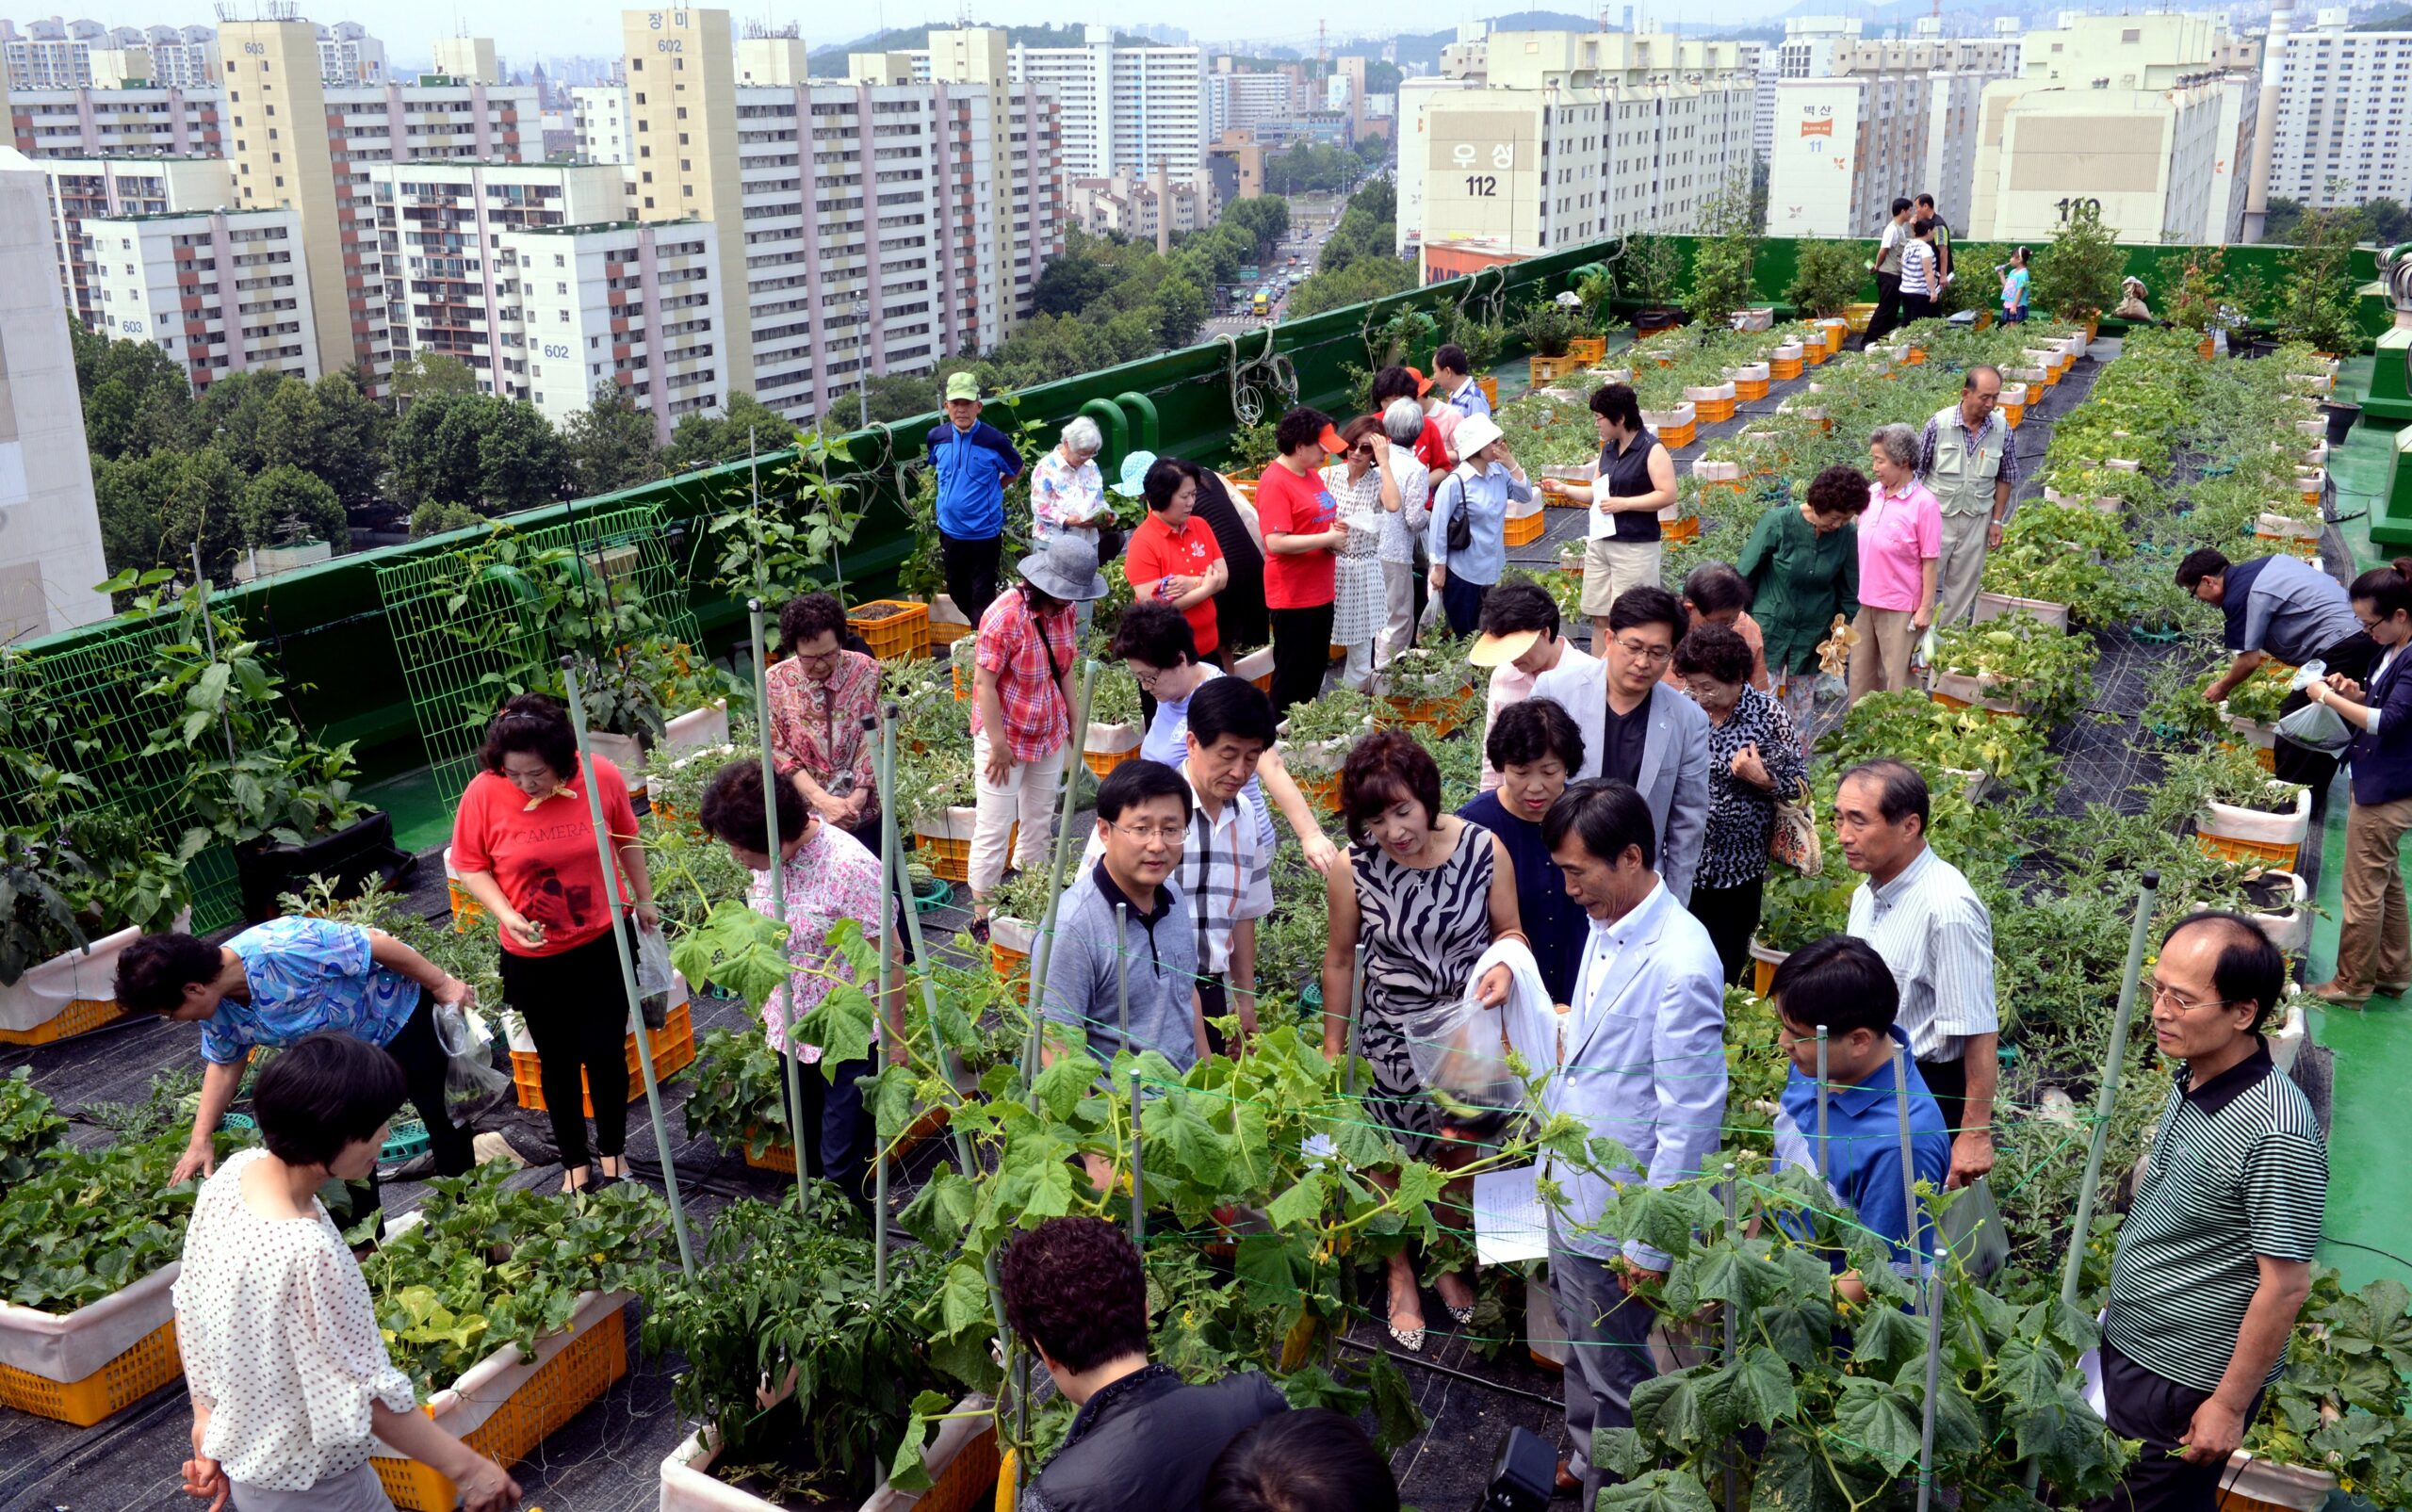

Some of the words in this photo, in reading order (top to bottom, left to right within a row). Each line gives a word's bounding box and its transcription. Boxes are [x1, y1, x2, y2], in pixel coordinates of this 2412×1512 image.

[245, 41, 264, 54] 603
[658, 39, 682, 52] 602
[1809, 140, 1822, 152] 11
[1465, 175, 1496, 196] 112
[122, 320, 142, 333] 603
[545, 345, 569, 358] 602
[513, 822, 591, 844] CAMERA
